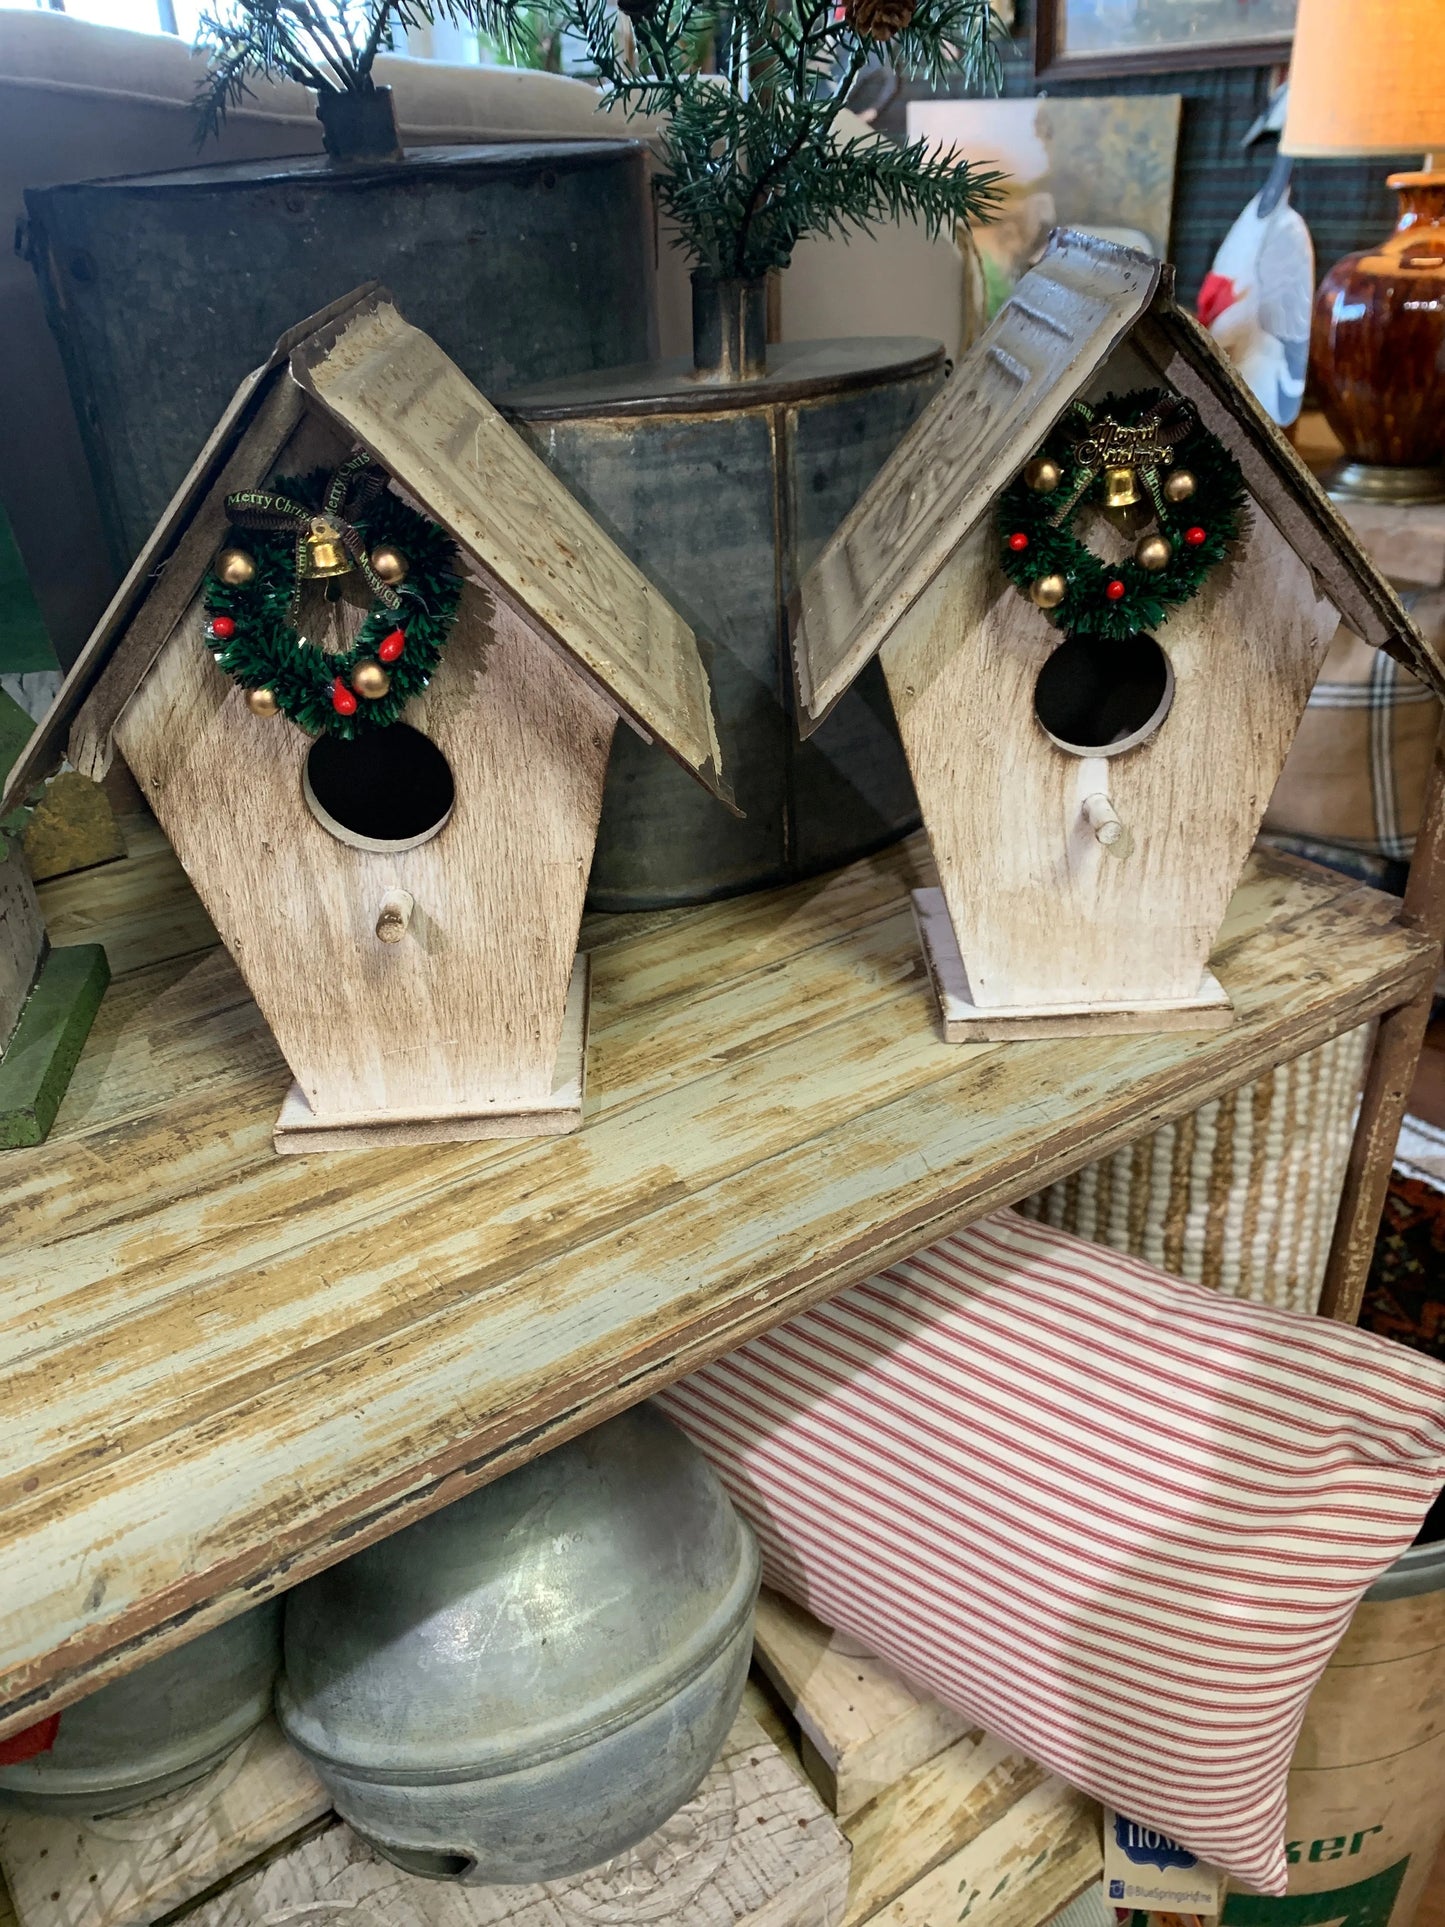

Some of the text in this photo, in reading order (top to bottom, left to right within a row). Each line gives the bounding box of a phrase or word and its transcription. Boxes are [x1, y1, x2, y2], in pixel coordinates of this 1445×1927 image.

[1089, 414, 1161, 451] Merry
[1073, 439, 1175, 468] Christmas
[227, 491, 273, 509] Merry
